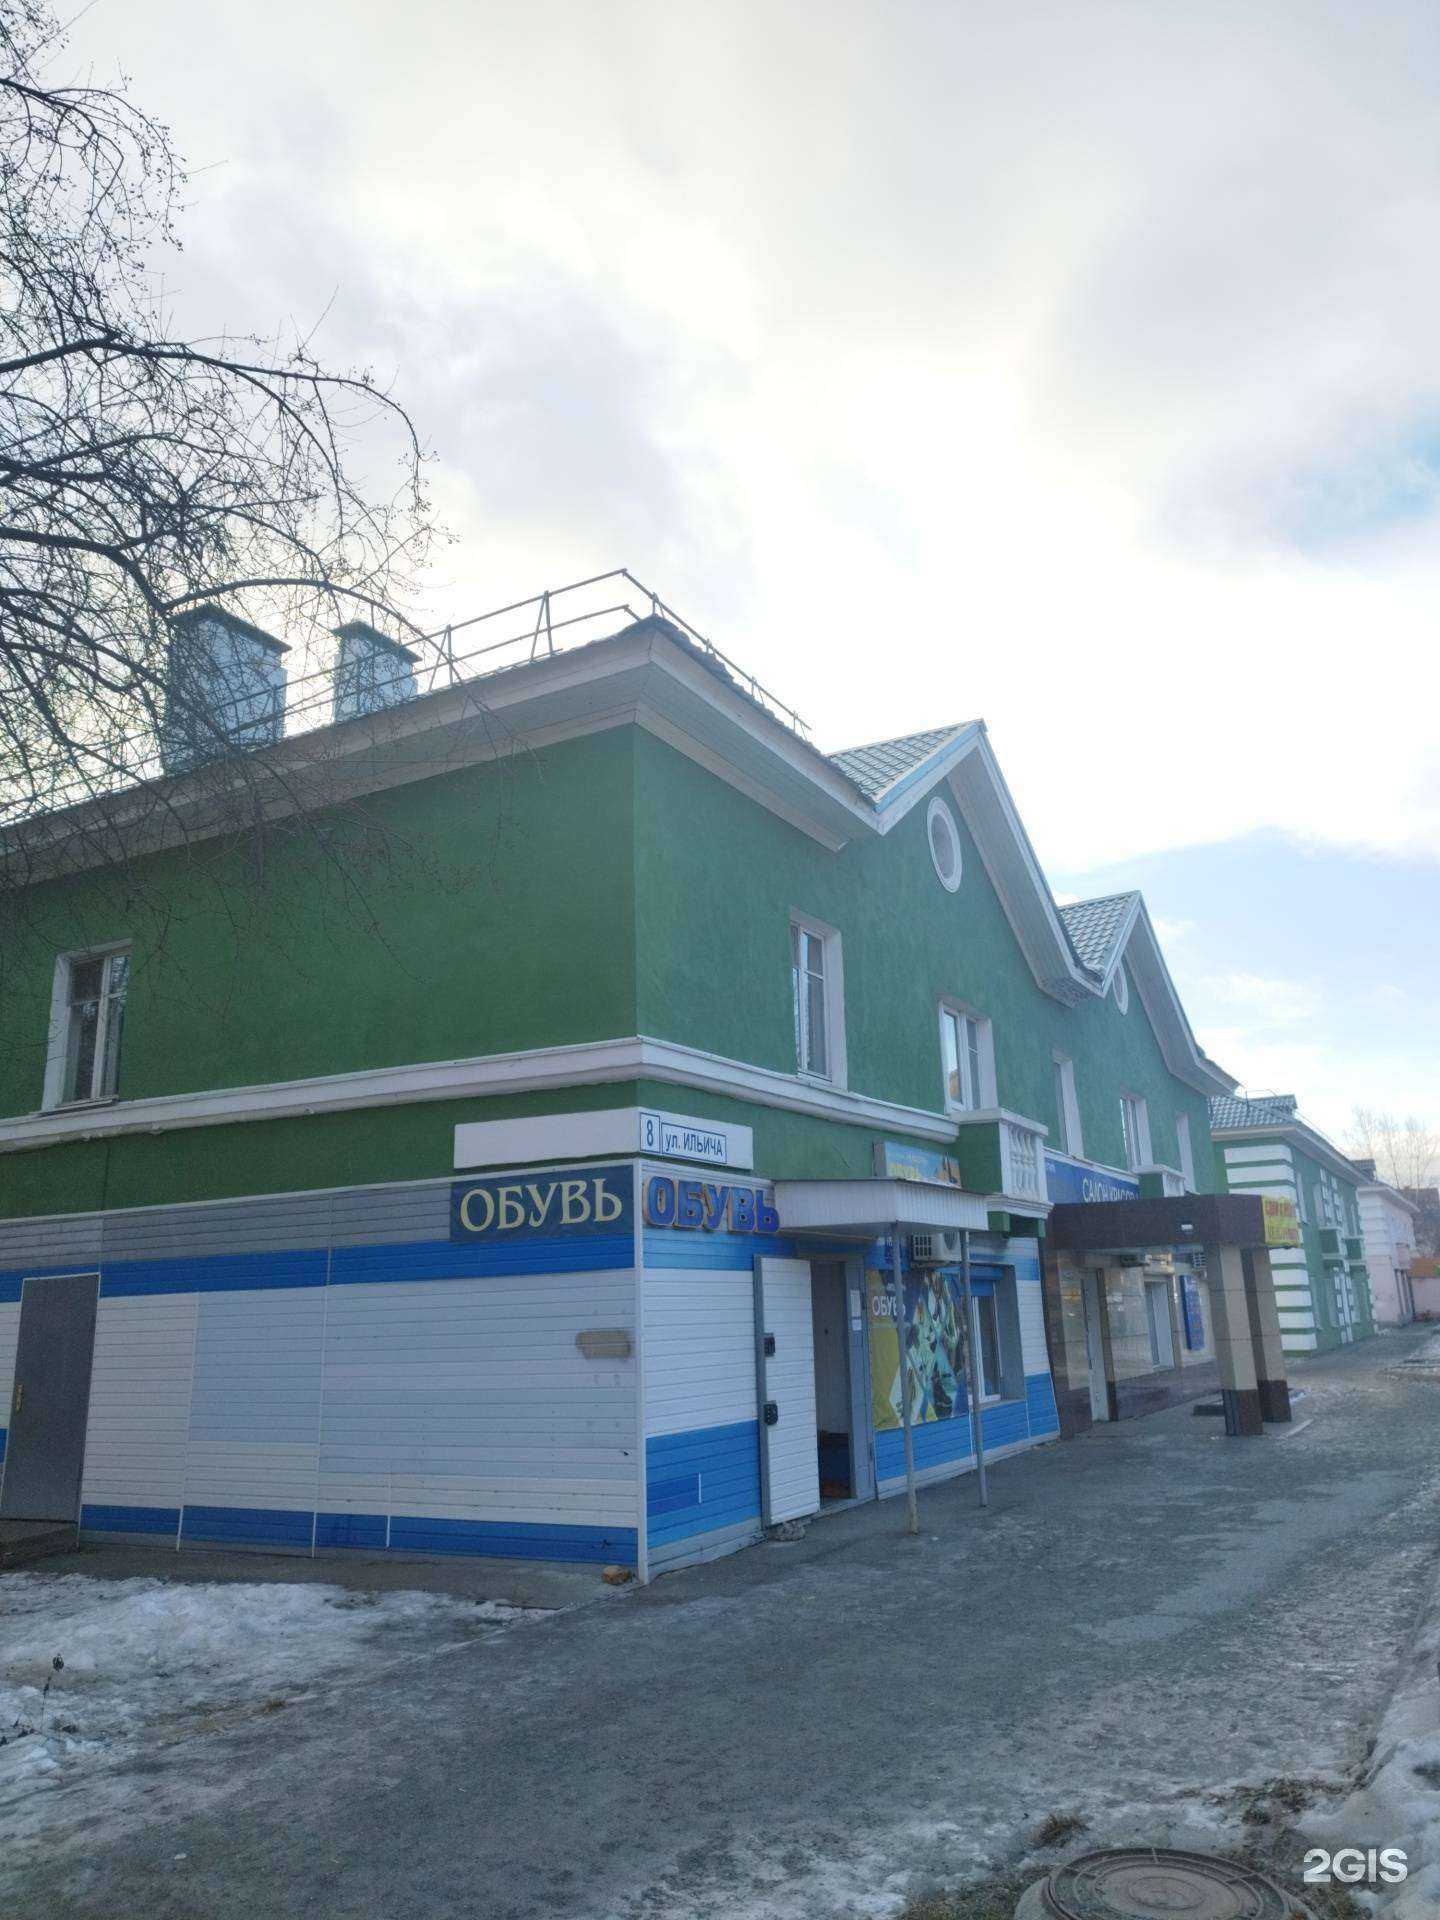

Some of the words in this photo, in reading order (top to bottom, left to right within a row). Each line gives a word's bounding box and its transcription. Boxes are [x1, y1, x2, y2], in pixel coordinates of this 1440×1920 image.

[646, 1119, 654, 1147] 8
[666, 1133, 681, 1152] ул.
[683, 1132, 723, 1157] ИЛЬИЧА
[460, 1178, 623, 1232] ОБУВЬ
[643, 1176, 780, 1233] ОБУВЬ
